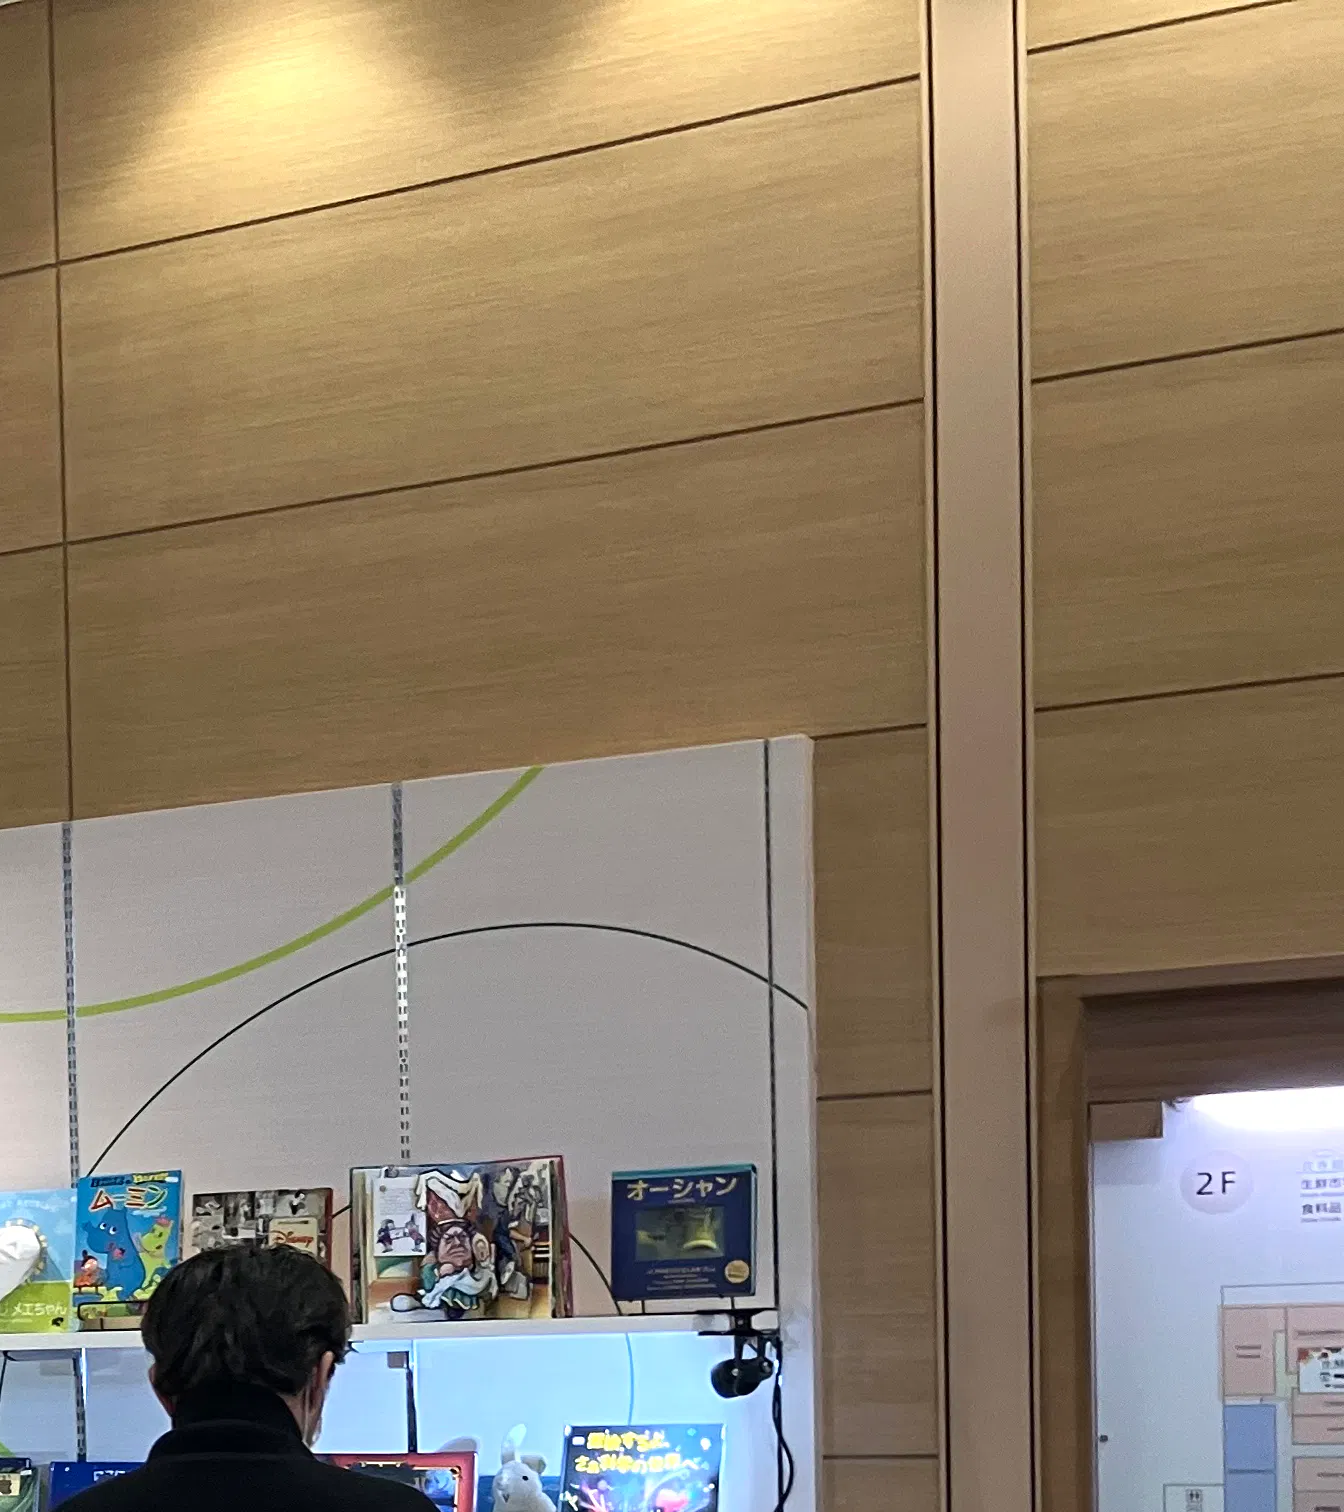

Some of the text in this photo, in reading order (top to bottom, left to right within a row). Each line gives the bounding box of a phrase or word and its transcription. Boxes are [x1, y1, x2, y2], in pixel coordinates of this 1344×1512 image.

[626, 1176, 737, 1201] オーシャン
[1196, 1171, 1236, 1195] 2F
[89, 1184, 169, 1212] ムーミン
